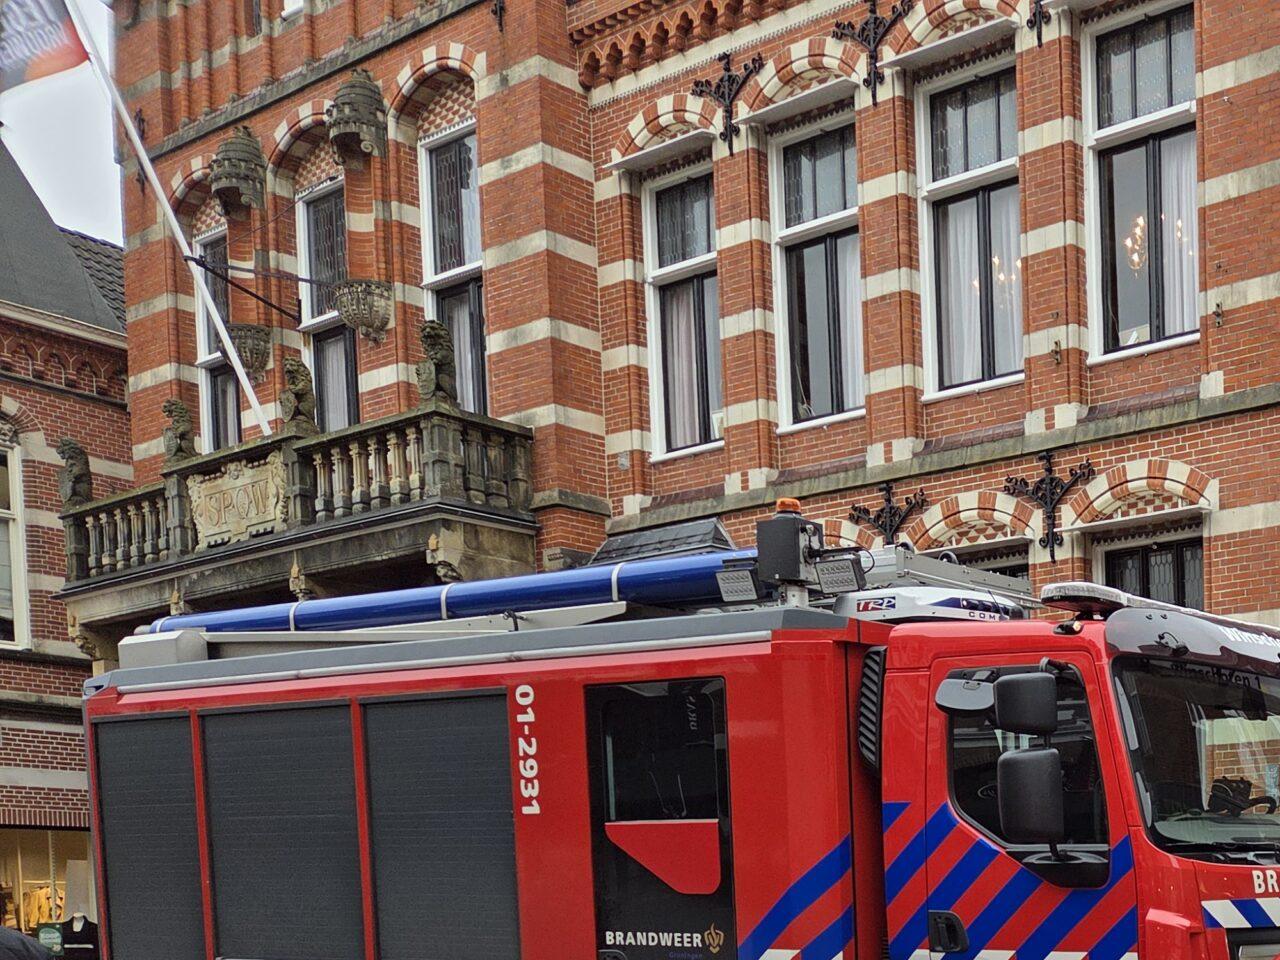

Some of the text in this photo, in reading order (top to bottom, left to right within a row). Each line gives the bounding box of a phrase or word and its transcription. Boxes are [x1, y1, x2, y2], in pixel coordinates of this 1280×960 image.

[858, 597, 895, 612] TRP
[968, 611, 1002, 621] COM
[515, 684, 540, 814] 01-2931
[605, 931, 702, 947] BRANDWEER
